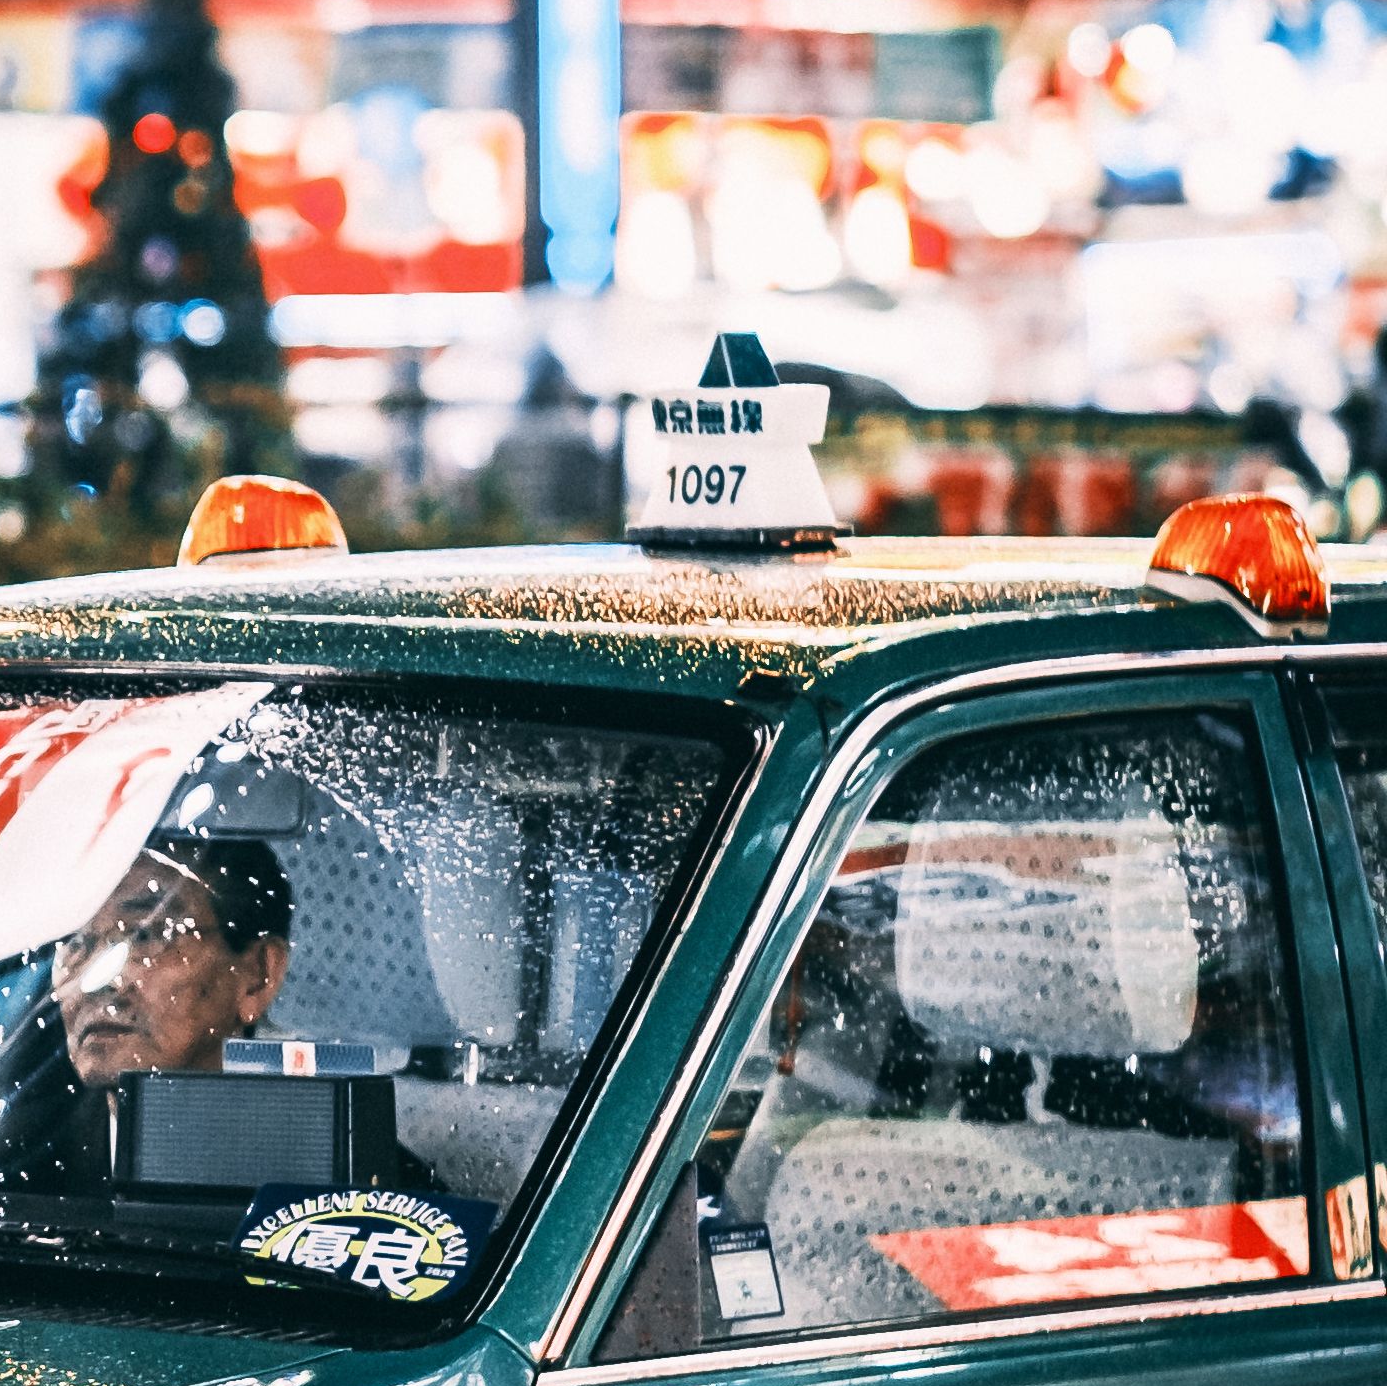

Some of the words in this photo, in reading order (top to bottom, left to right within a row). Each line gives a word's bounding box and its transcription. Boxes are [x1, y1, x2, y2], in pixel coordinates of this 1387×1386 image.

[666, 464, 747, 505] 1097
[240, 1190, 361, 1250] EXCELLENT
[364, 1189, 451, 1233] SERVICE
[440, 1224, 469, 1267] TAXI
[269, 1221, 428, 1298] 優良
